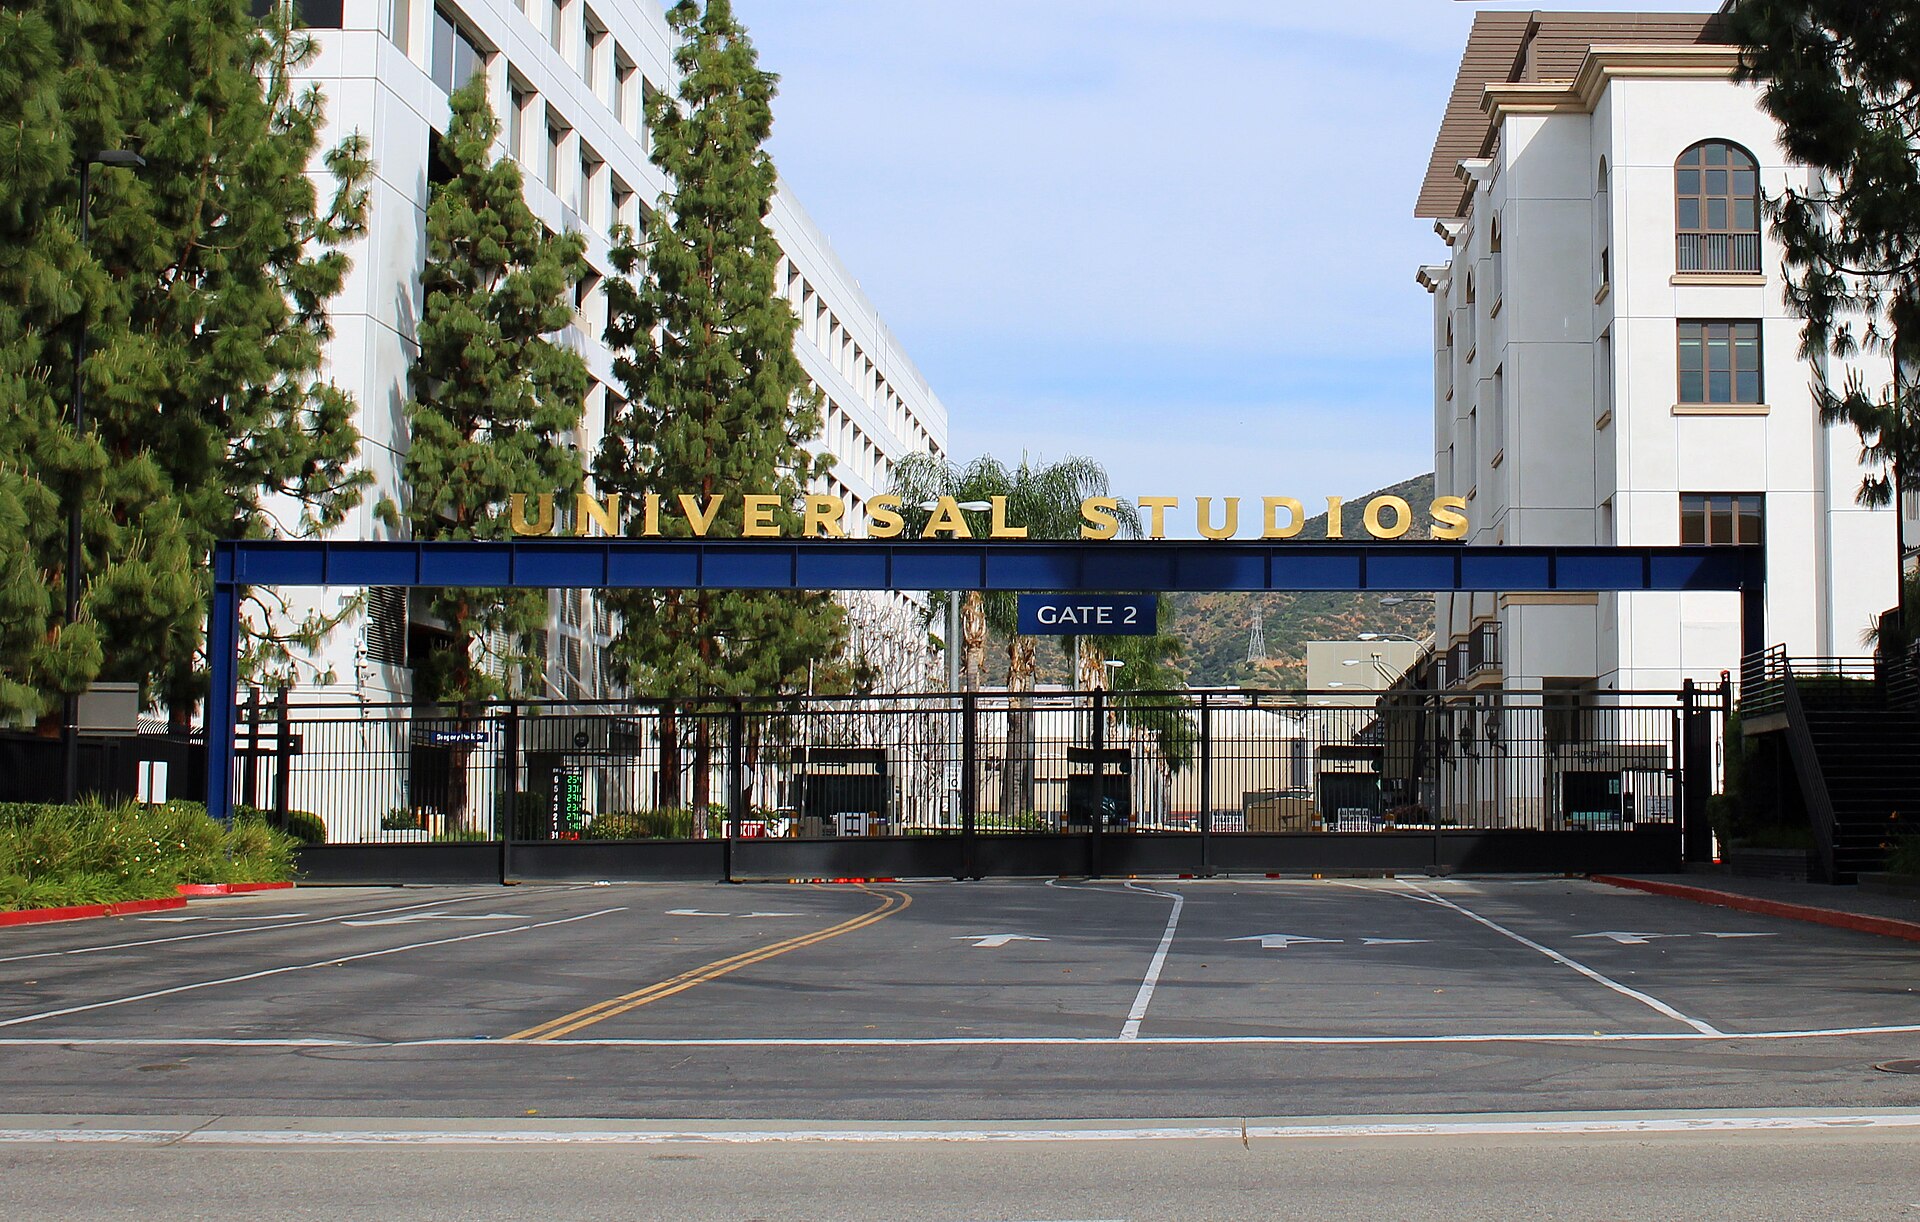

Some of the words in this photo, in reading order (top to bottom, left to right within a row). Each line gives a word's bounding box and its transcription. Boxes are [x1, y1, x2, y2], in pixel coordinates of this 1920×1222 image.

[510, 493, 1028, 538] UNIVERSAL
[1080, 495, 1469, 539] STUDIOS
[1037, 606, 1113, 624] GATE
[1123, 606, 1137, 624] 2
[553, 775, 559, 784] 6
[553, 784, 559, 793] 5
[553, 794, 559, 802] 4
[553, 803, 559, 812] 3
[552, 812, 559, 821] 2
[553, 822, 558, 830] 1
